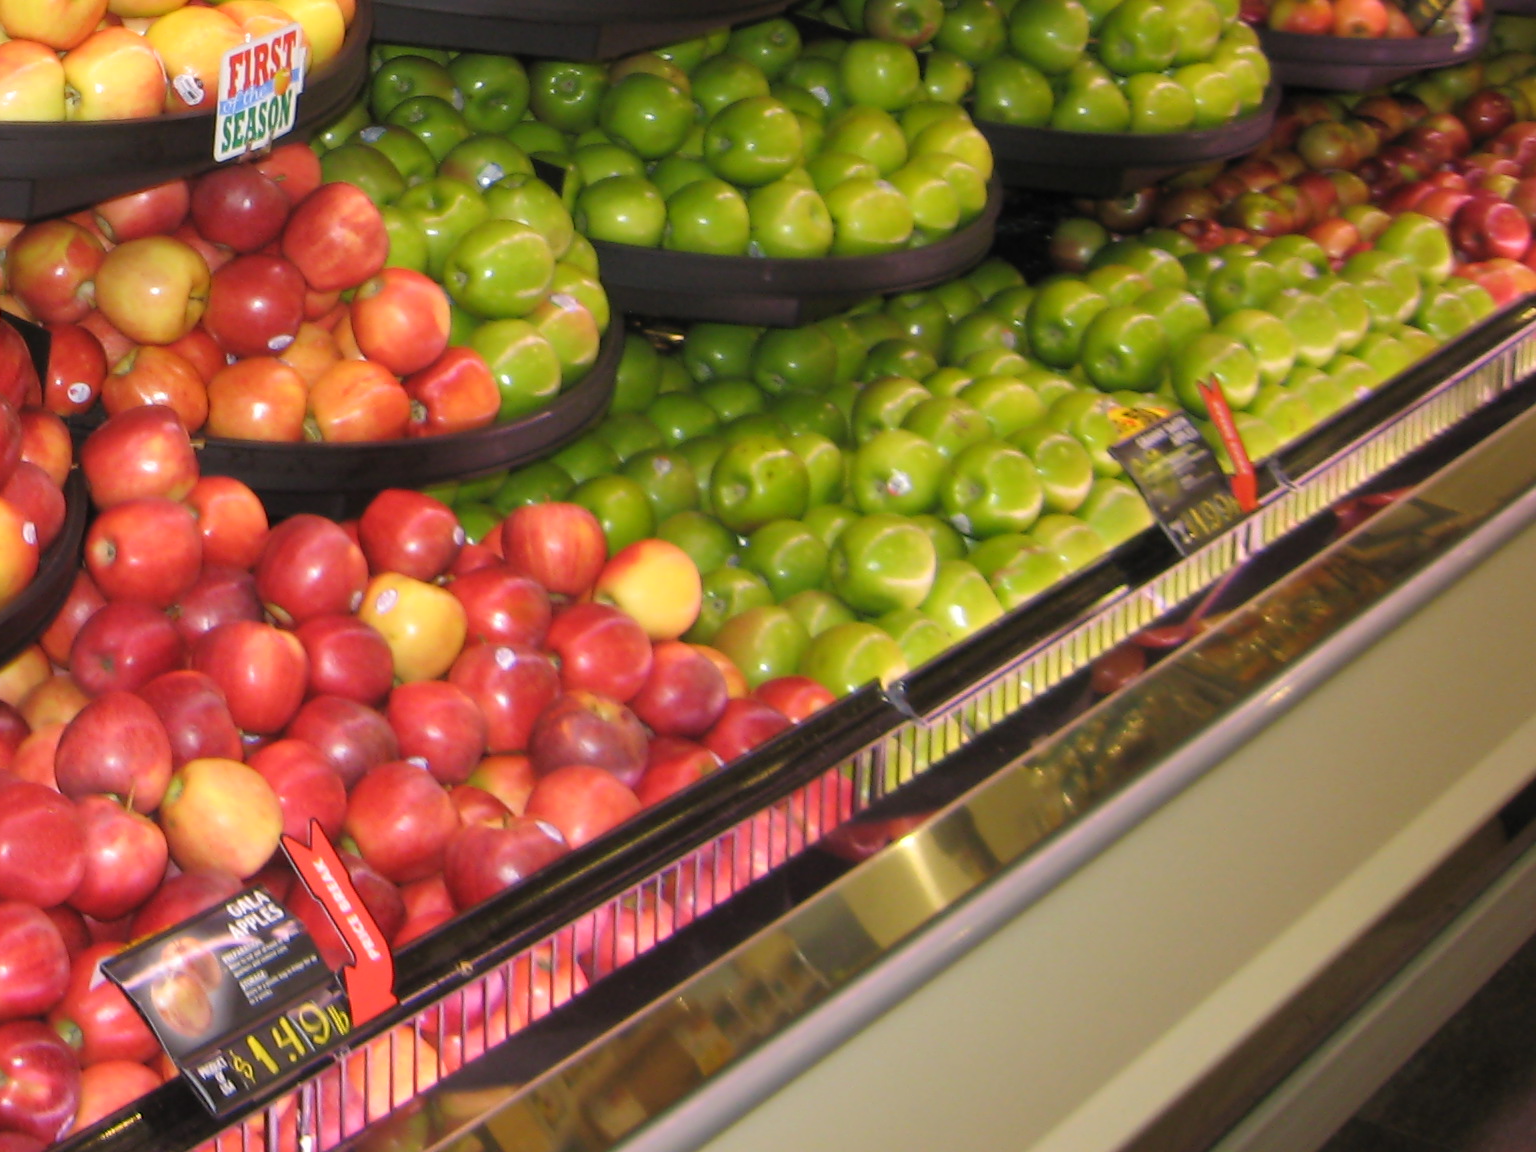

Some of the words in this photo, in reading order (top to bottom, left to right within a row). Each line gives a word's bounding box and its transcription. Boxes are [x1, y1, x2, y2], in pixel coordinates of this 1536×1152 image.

[227, 30, 297, 99] FIRST
[221, 88, 293, 154] SEASON
[226, 889, 271, 919] GALA
[312, 857, 352, 914] BREAK
[227, 903, 285, 941] APPLES
[347, 913, 382, 962] PRICE
[229, 1002, 331, 1084] $1.49
